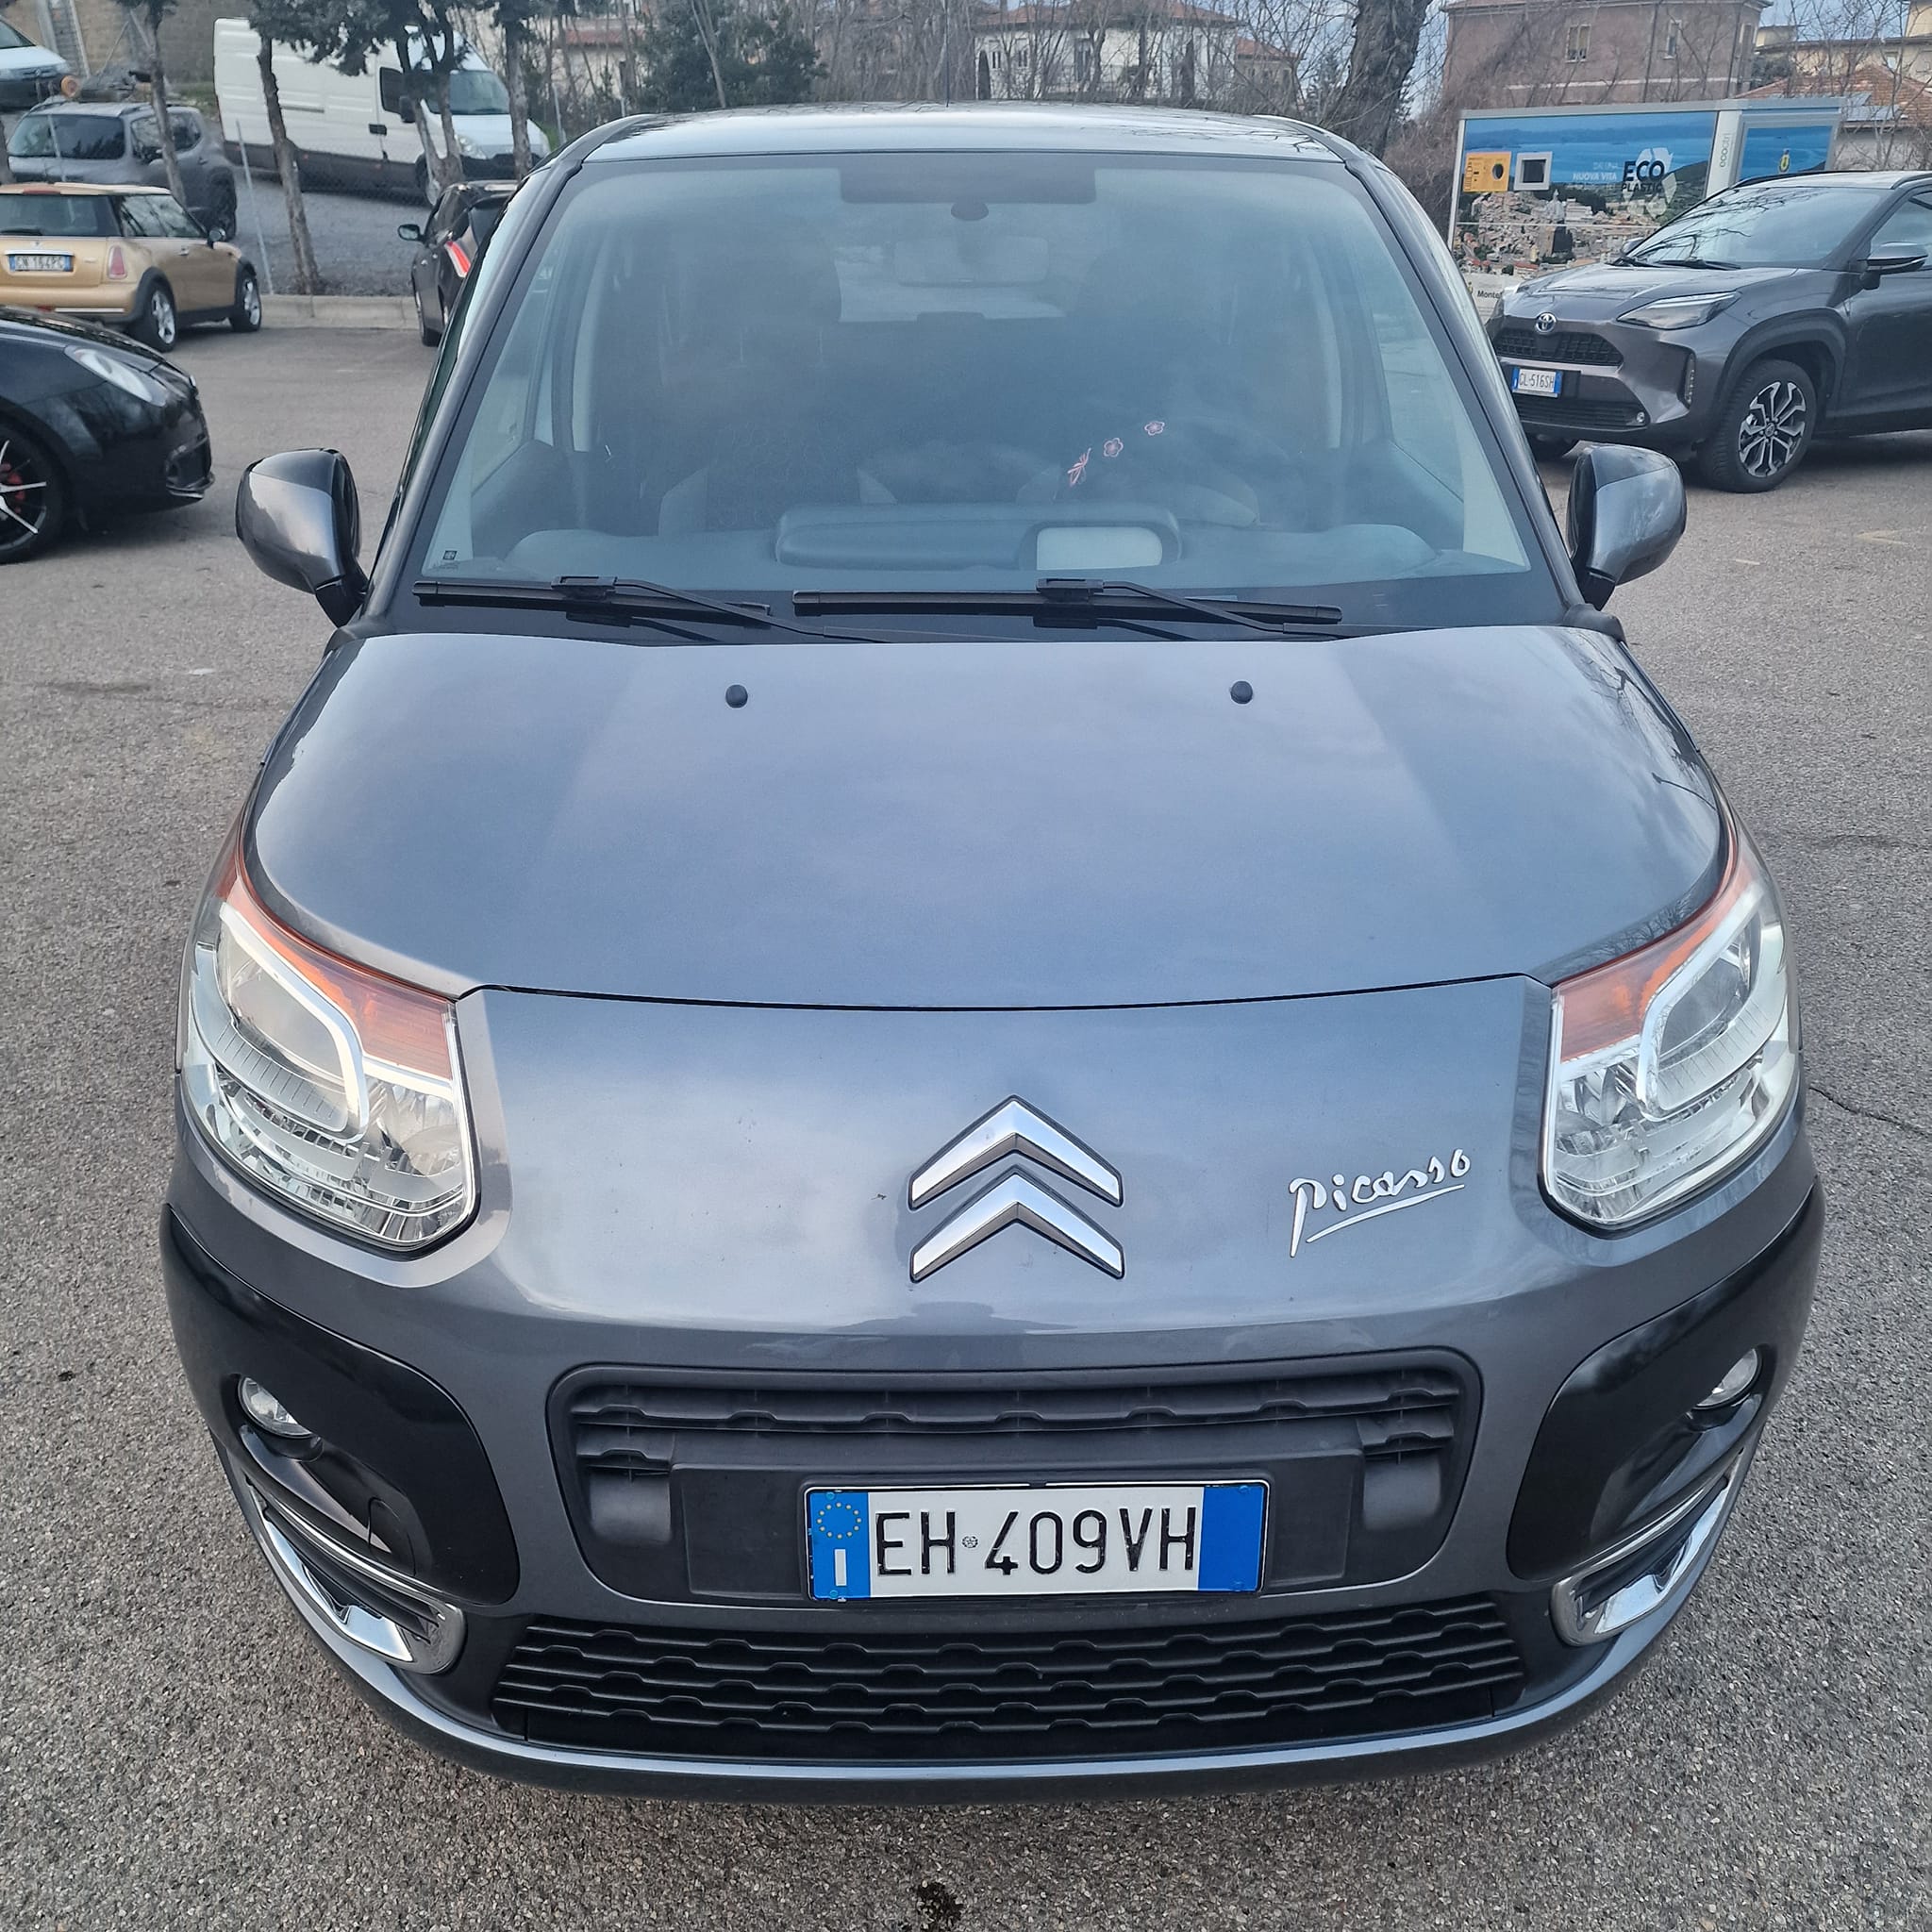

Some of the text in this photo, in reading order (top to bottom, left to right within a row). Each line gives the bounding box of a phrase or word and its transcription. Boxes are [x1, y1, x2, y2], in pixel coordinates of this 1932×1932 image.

[1572, 172, 1617, 181] NUOVA VITA
[1623, 159, 1665, 182] ECO
